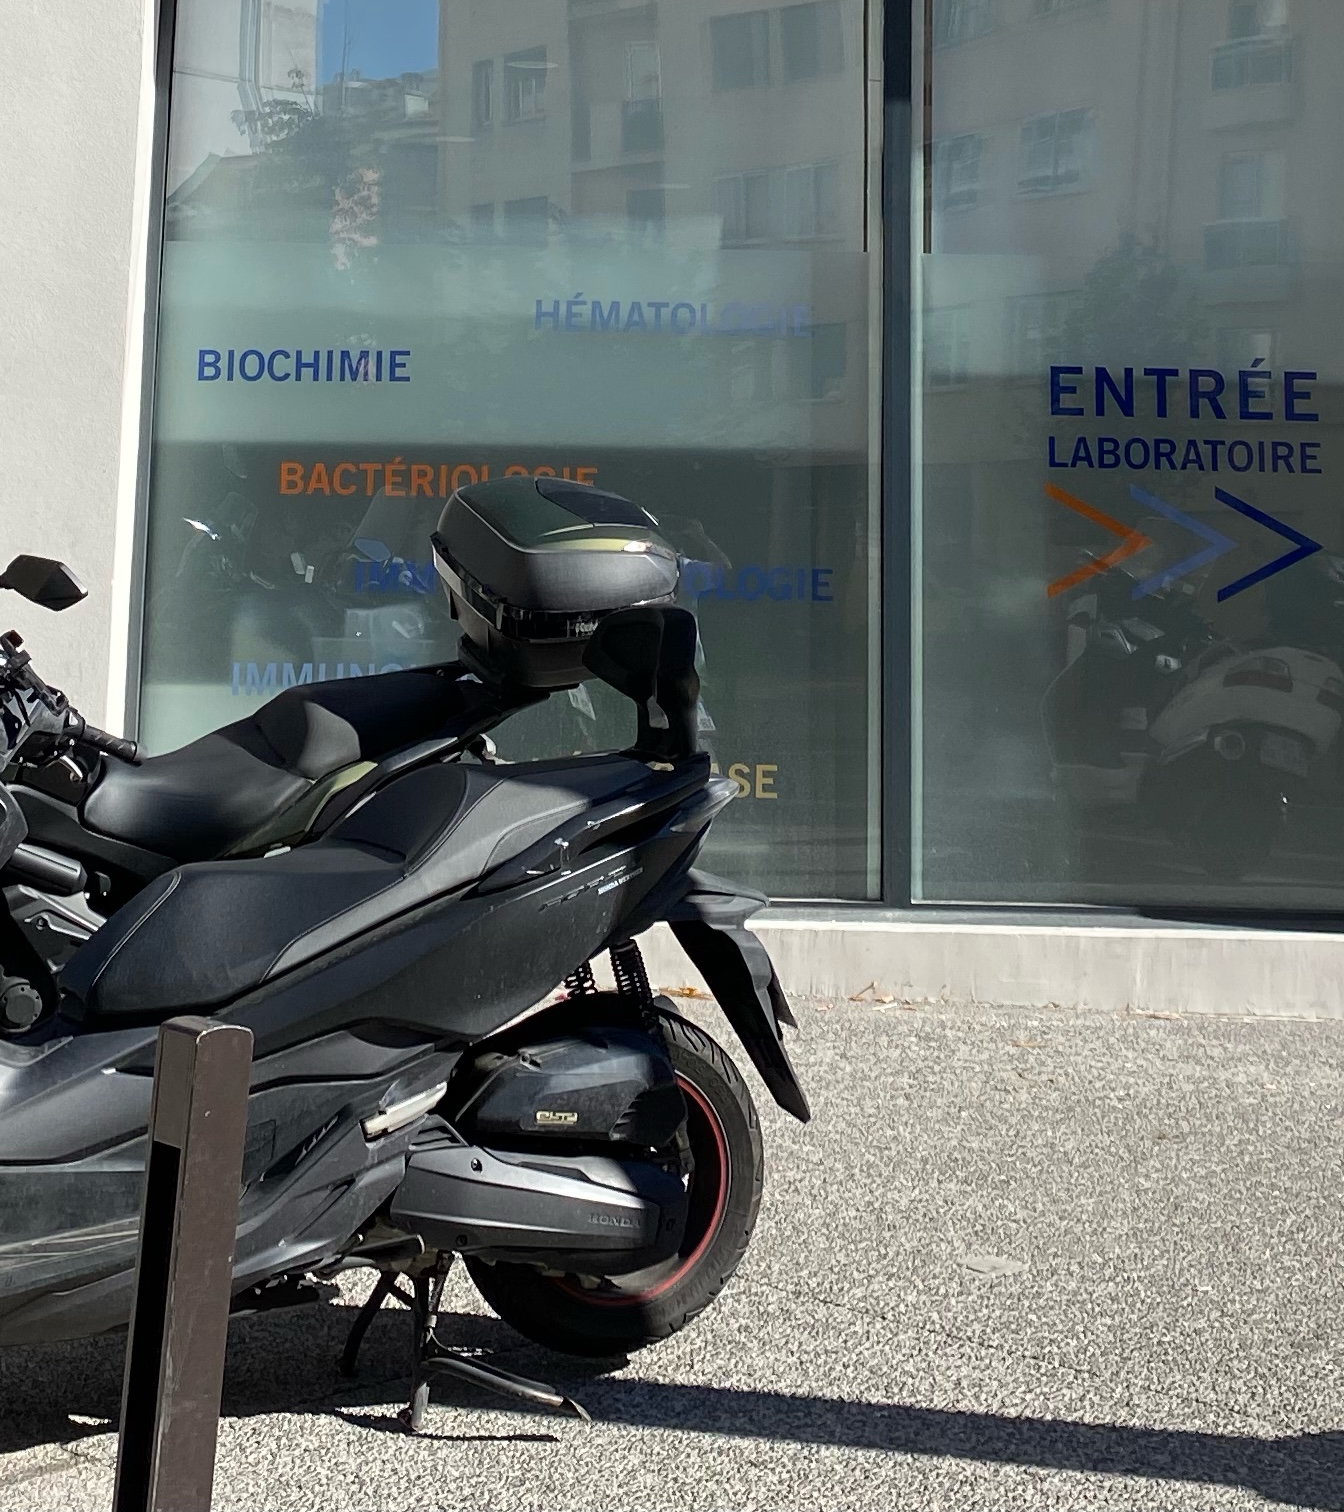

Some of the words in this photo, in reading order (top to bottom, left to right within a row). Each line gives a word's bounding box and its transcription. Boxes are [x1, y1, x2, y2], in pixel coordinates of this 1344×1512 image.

[196, 348, 412, 383] BIOCHIMIE
[1047, 357, 1321, 423] ENTRÉE
[1047, 435, 1323, 475] LABORATOIRE
[587, 1213, 641, 1229] HONDA
